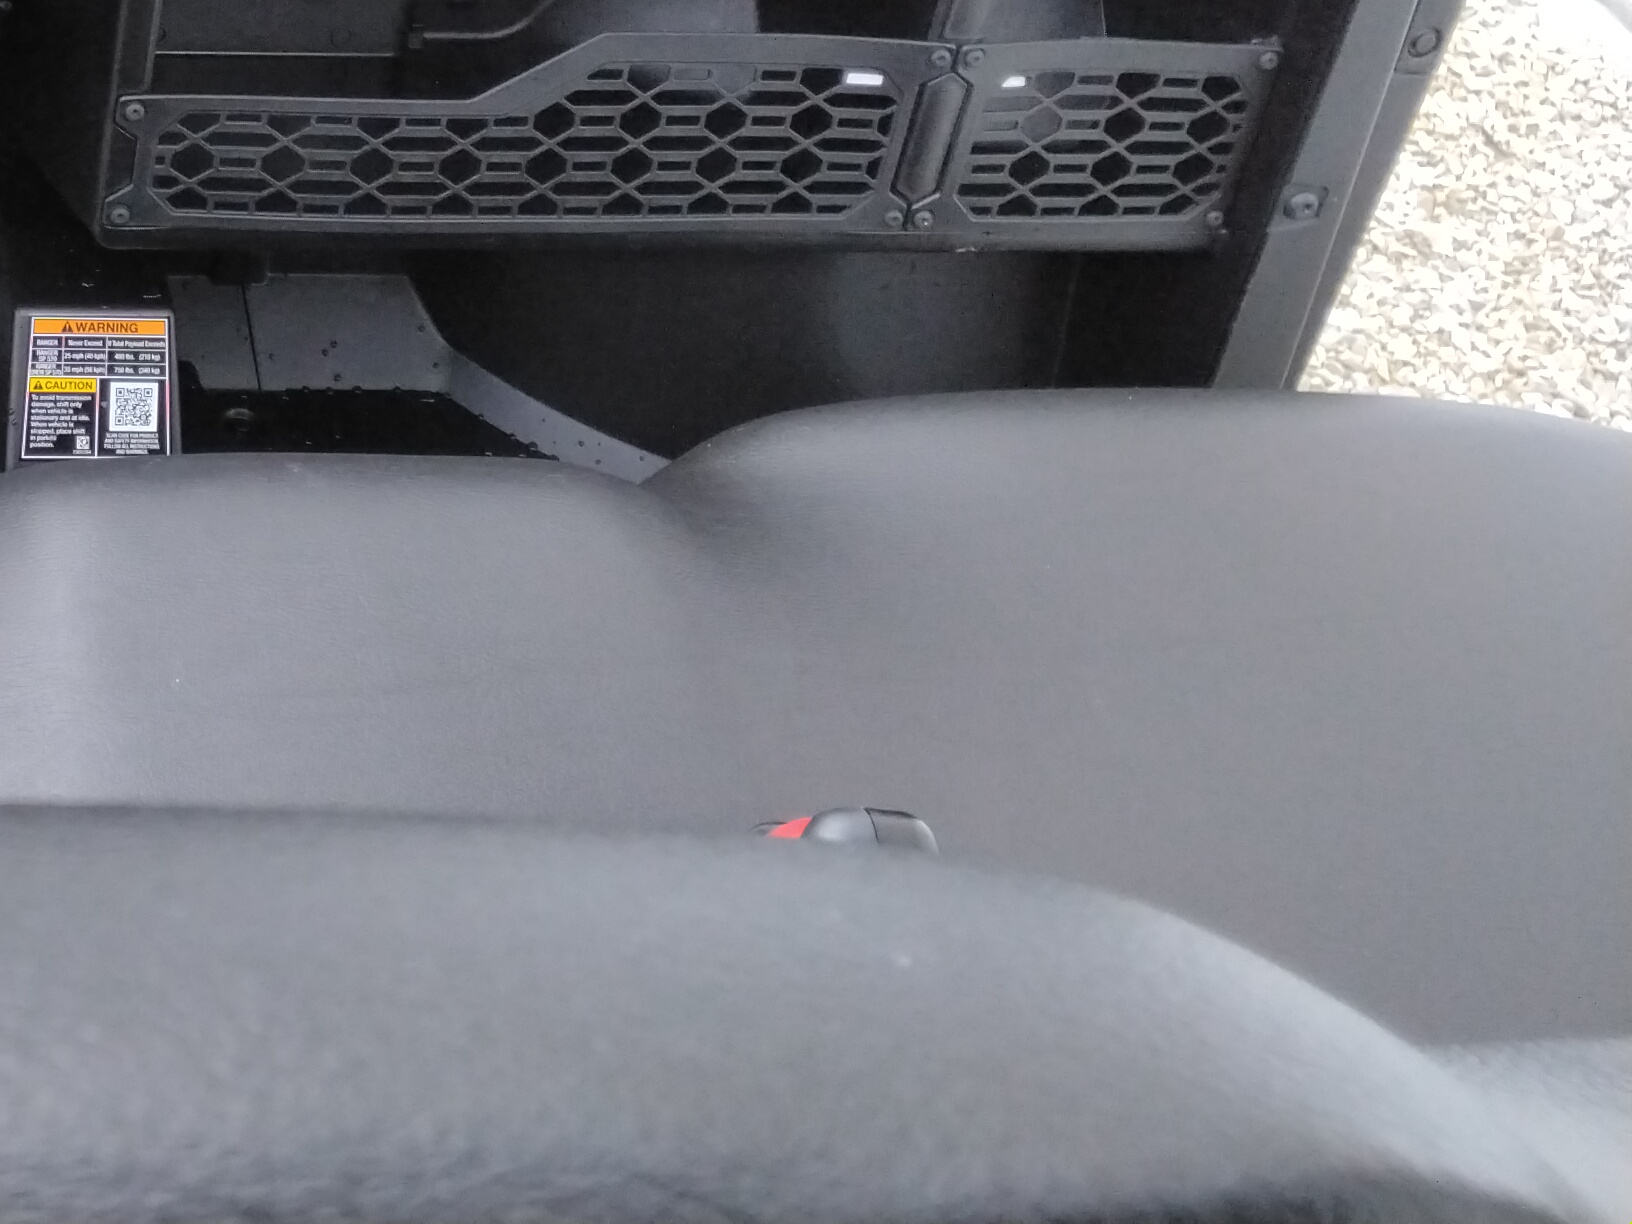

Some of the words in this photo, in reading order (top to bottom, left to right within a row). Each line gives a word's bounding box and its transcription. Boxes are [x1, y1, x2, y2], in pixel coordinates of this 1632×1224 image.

[76, 322, 138, 333] WARNING
[72, 353, 84, 361] mph
[45, 380, 93, 390] CAUTION
